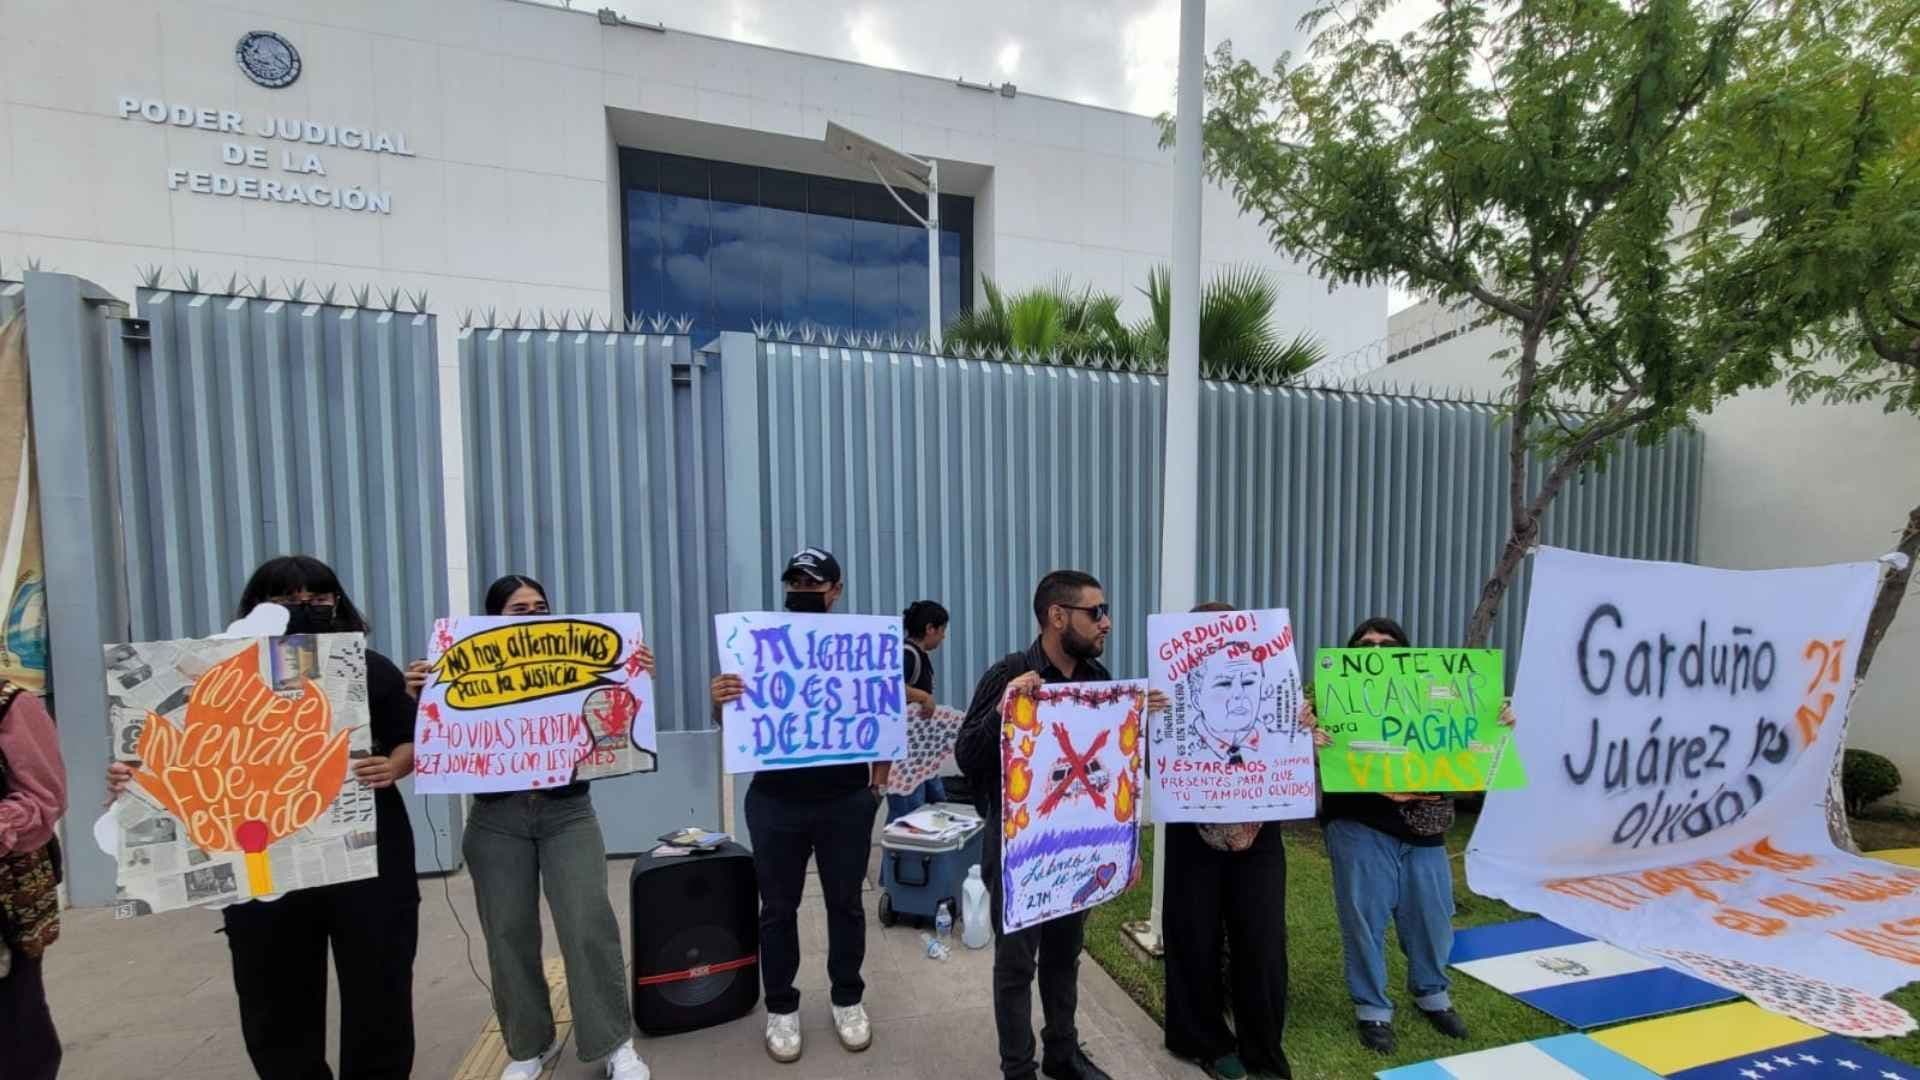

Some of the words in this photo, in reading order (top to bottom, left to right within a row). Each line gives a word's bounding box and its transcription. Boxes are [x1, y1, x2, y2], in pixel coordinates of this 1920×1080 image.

[119, 97, 244, 135] PODER
[258, 116, 416, 157] JUDICIAL
[222, 143, 270, 169] DE
[282, 151, 327, 175] LA
[167, 168, 392, 215] FEDERACIÓN
[472, 640, 508, 671] hay
[750, 623, 900, 673] MIGRAR
[1159, 612, 1257, 661] GARDUÑO!
[1577, 603, 1777, 700] Garduño
[1339, 652, 1385, 677] NO
[1391, 652, 1430, 675] TE
[1440, 652, 1477, 675] VA
[735, 670, 796, 711] NO
[800, 673, 842, 715] ES
[852, 673, 902, 715] UN
[467, 717, 516, 750] VIDAS
[752, 711, 880, 756] DELITO
[1381, 713, 1479, 754] PAGAR
[1564, 716, 1731, 789] Juárez
[443, 750, 505, 777] JOVENES
[1160, 775, 1232, 792] PRESENTES
[1236, 774, 1265, 786] PARA
[1271, 770, 1295, 783] QUE
[1172, 759, 1267, 775] ESTAREMOS
[1346, 750, 1488, 792] VIDAS
[1201, 786, 1263, 801] TAMPOCO
